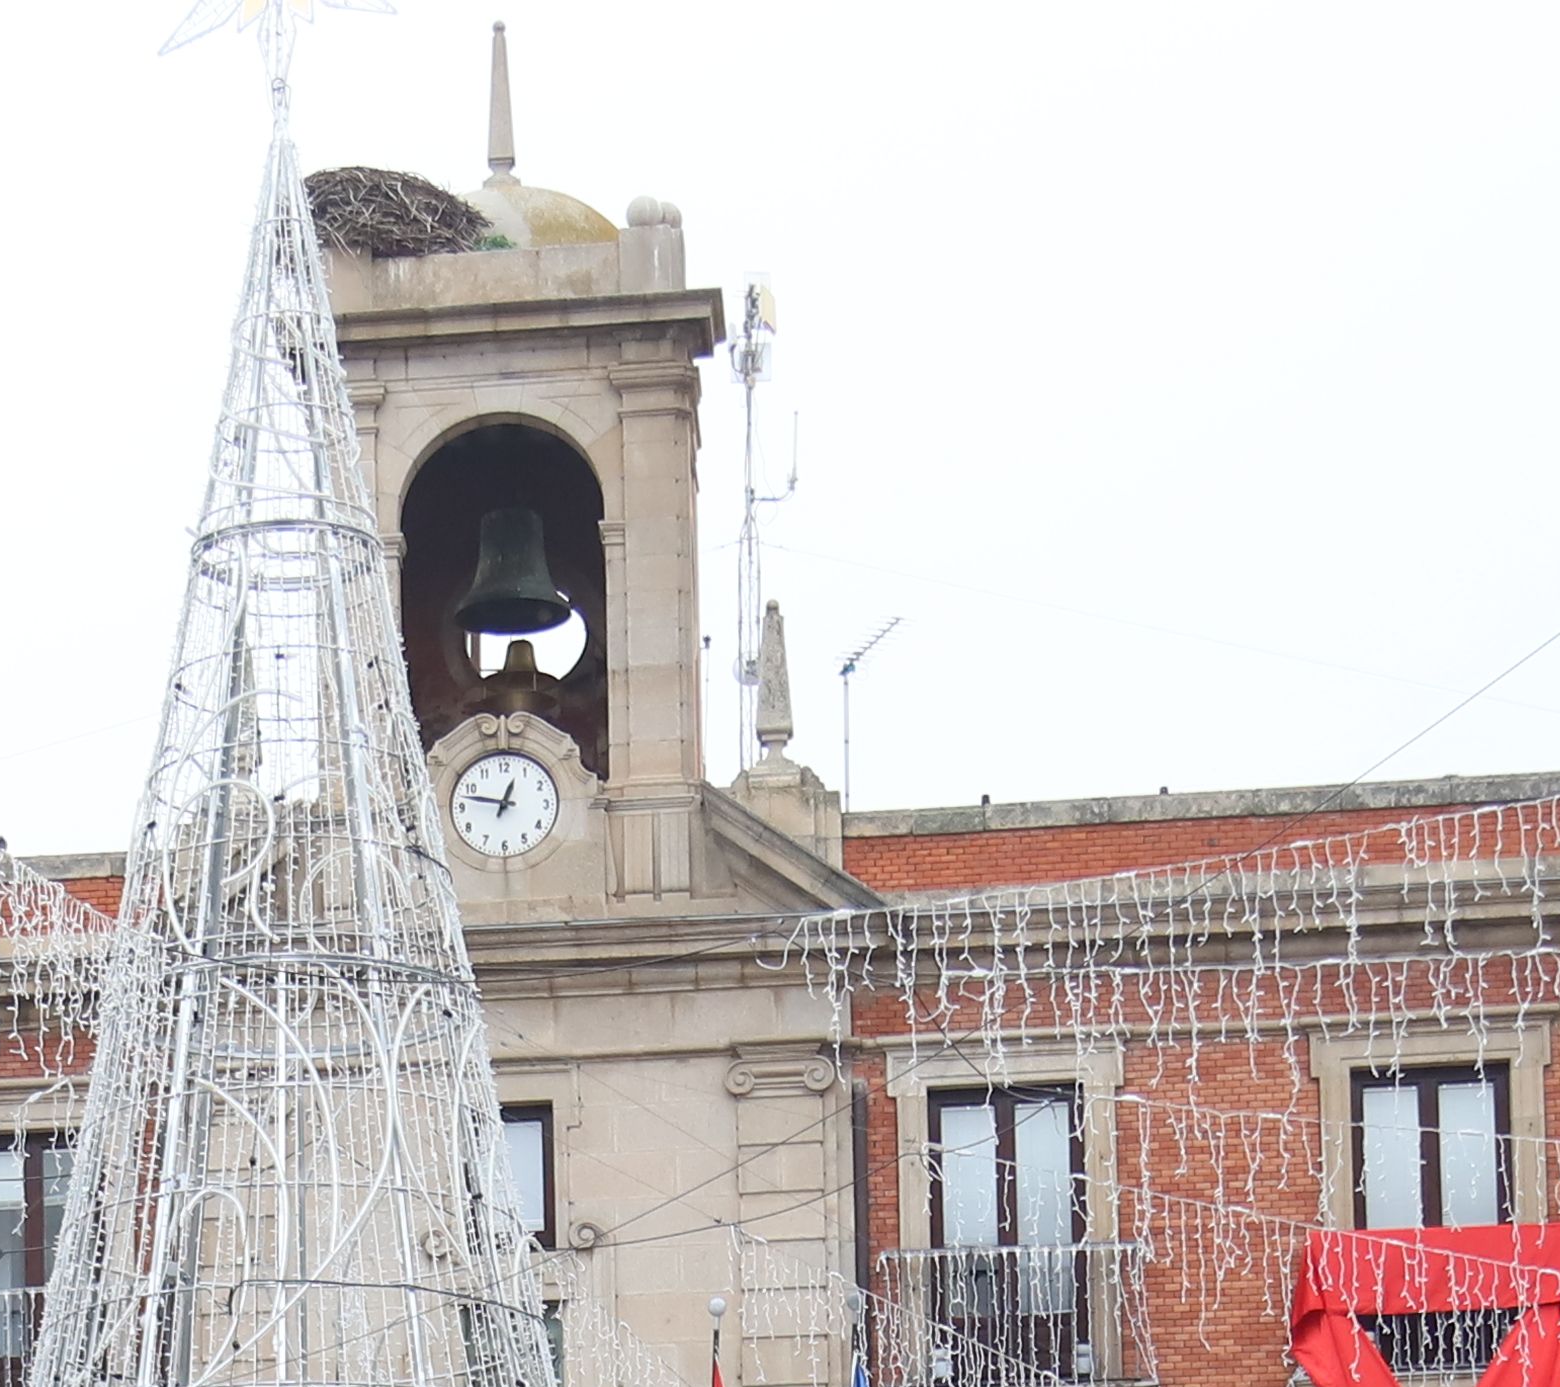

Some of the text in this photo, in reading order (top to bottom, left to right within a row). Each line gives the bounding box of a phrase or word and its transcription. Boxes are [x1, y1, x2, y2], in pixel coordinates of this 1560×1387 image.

[499, 762, 510, 773] 12
[522, 767, 527, 778] 1
[480, 768, 489, 779] 11
[465, 783, 477, 794] 10
[536, 781, 543, 791] 2
[459, 802, 465, 813] 9
[543, 799, 550, 810] 3
[465, 822, 472, 833] 8
[535, 819, 542, 830] 4
[482, 835, 489, 846] 7
[521, 833, 528, 844] 5
[501, 840, 508, 851] 6
